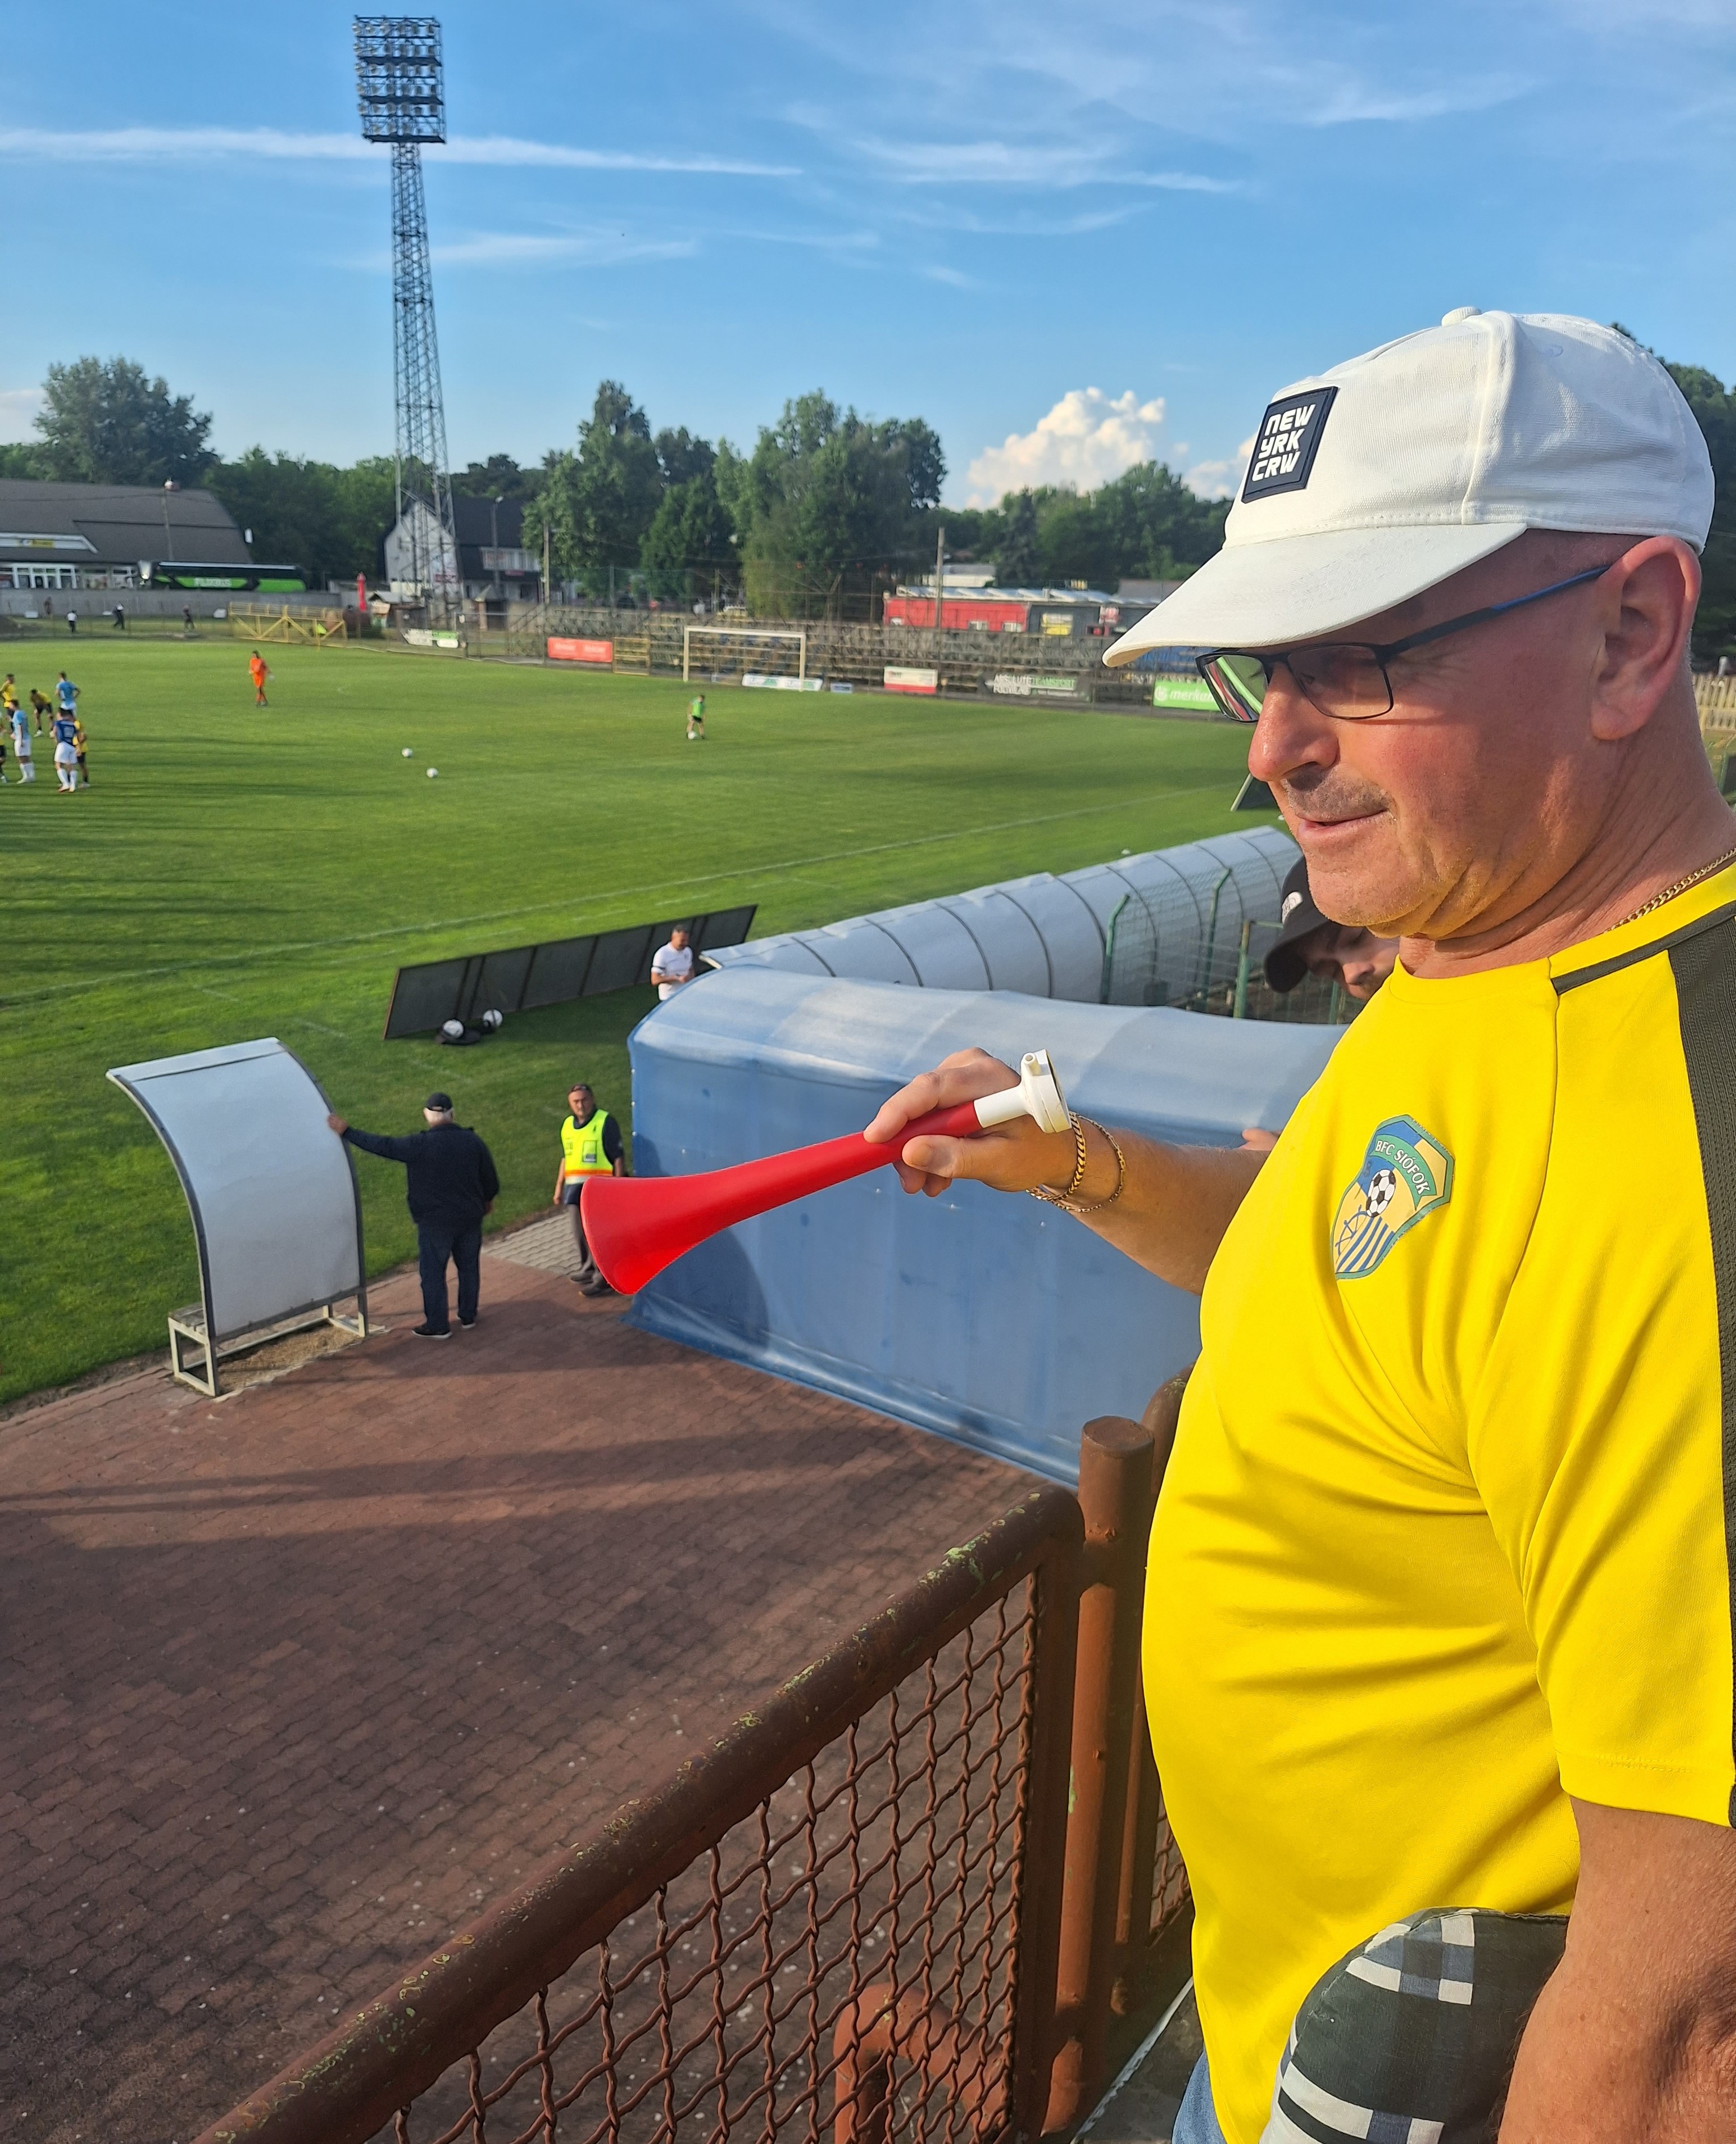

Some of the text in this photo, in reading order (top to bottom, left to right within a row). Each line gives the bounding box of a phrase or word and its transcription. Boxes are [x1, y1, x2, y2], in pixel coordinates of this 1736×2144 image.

[1265, 404, 1316, 436] NEW
[1258, 428, 1305, 459] YRK
[1252, 451, 1300, 482] CRW
[1375, 1140, 1430, 1195] BFC SIÓFOK
